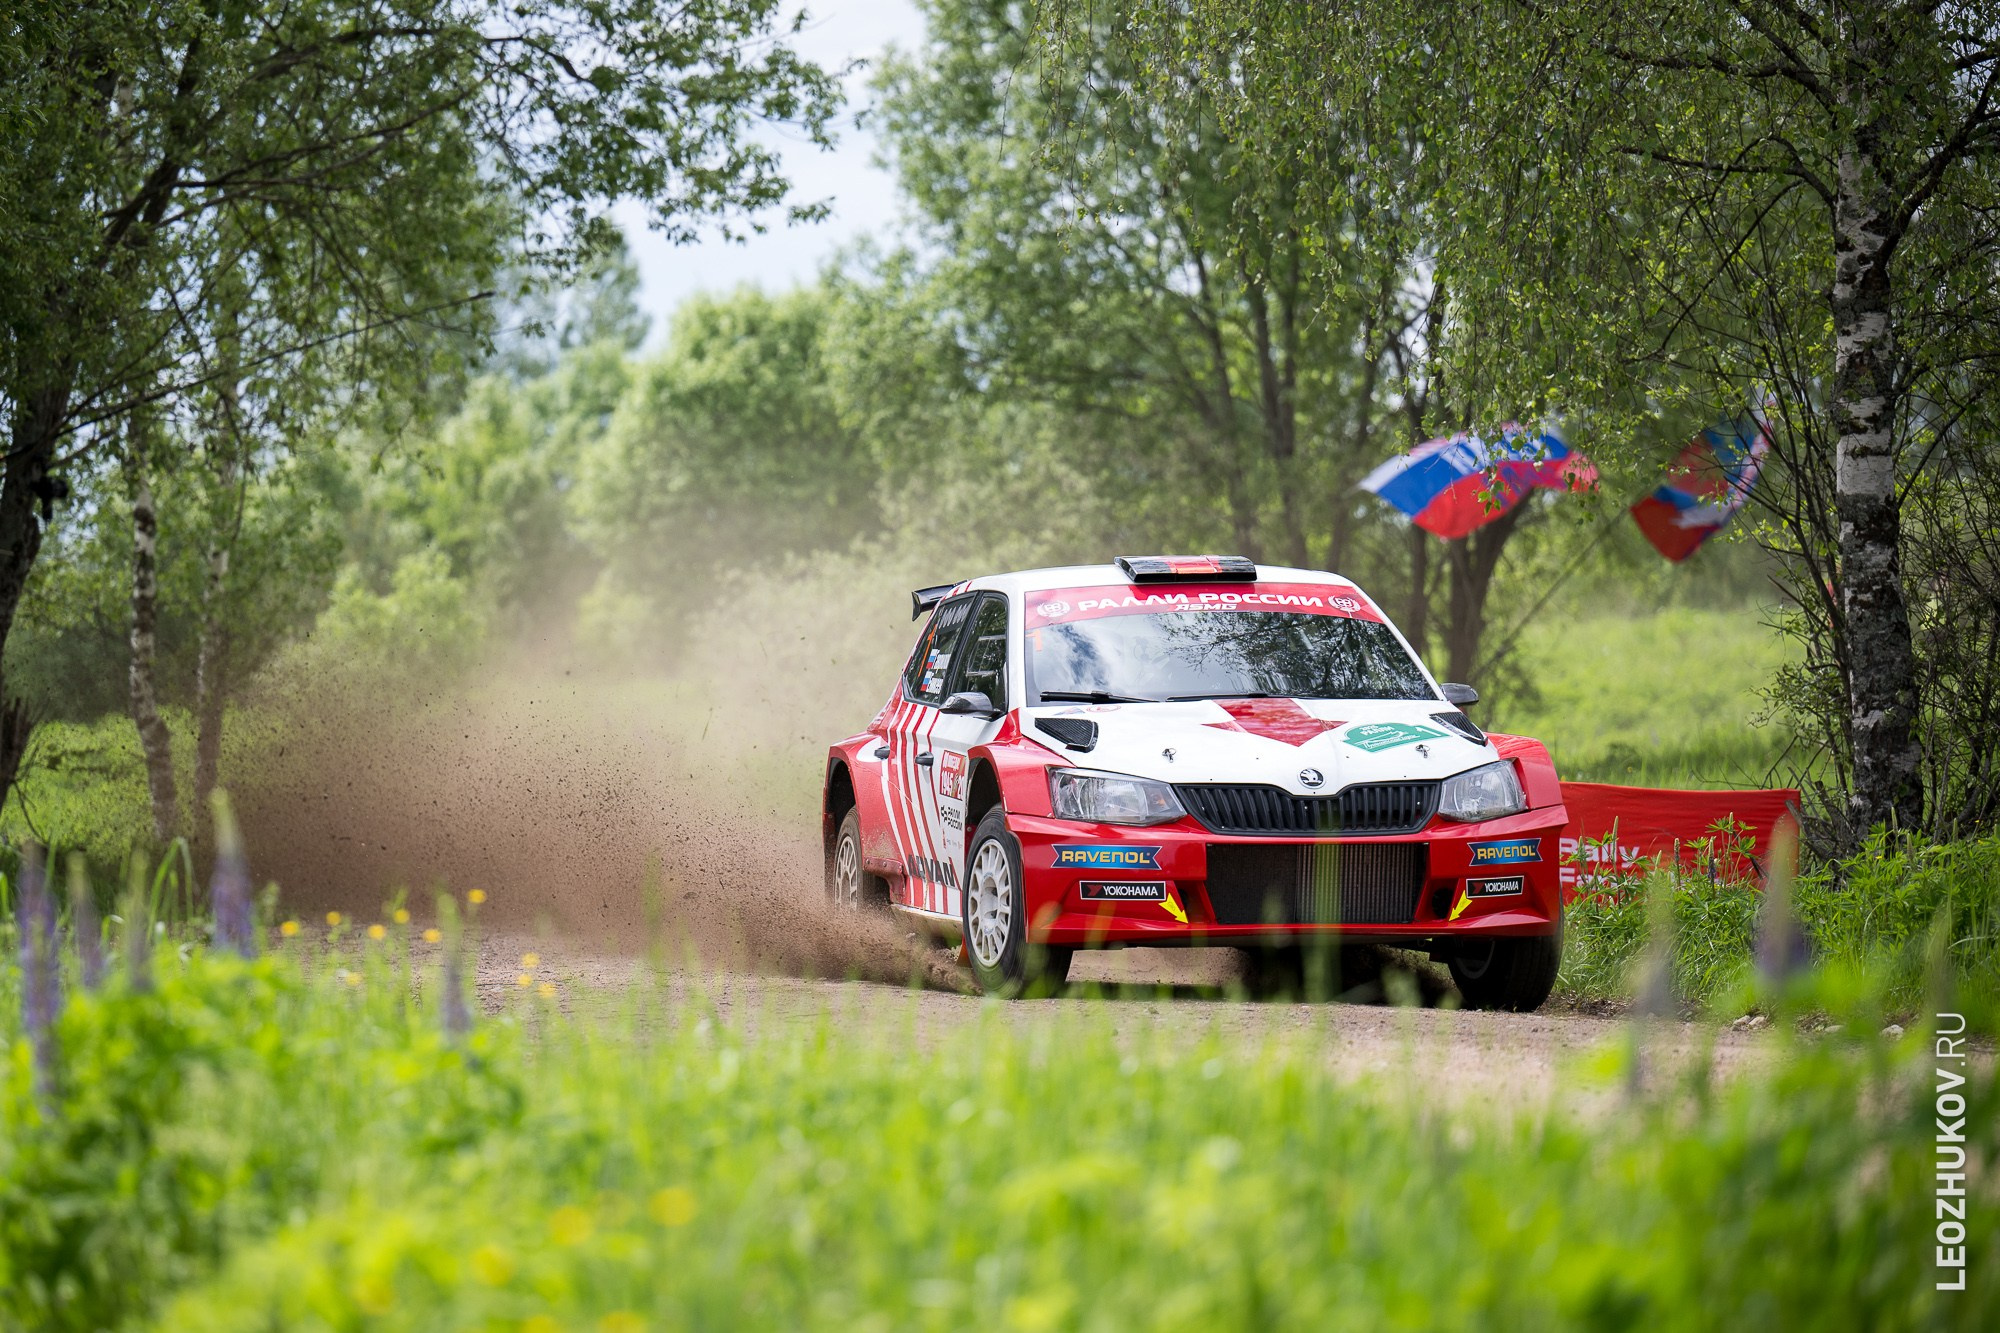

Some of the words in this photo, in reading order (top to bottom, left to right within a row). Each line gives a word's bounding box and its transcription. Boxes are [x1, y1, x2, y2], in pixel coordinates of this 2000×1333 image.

[1077, 594, 1189, 611] РАЛЛИ
[1198, 593, 1323, 607] РОССИИ
[1415, 727, 1442, 737] 1
[1062, 850, 1150, 864] RAVENOL
[1477, 845, 1536, 860] RAVENOL
[1559, 837, 1640, 868] Rally
[908, 854, 955, 887] ADVAN
[1103, 886, 1158, 896] YOKOHAMA
[1485, 881, 1519, 892] YOKOHAMA
